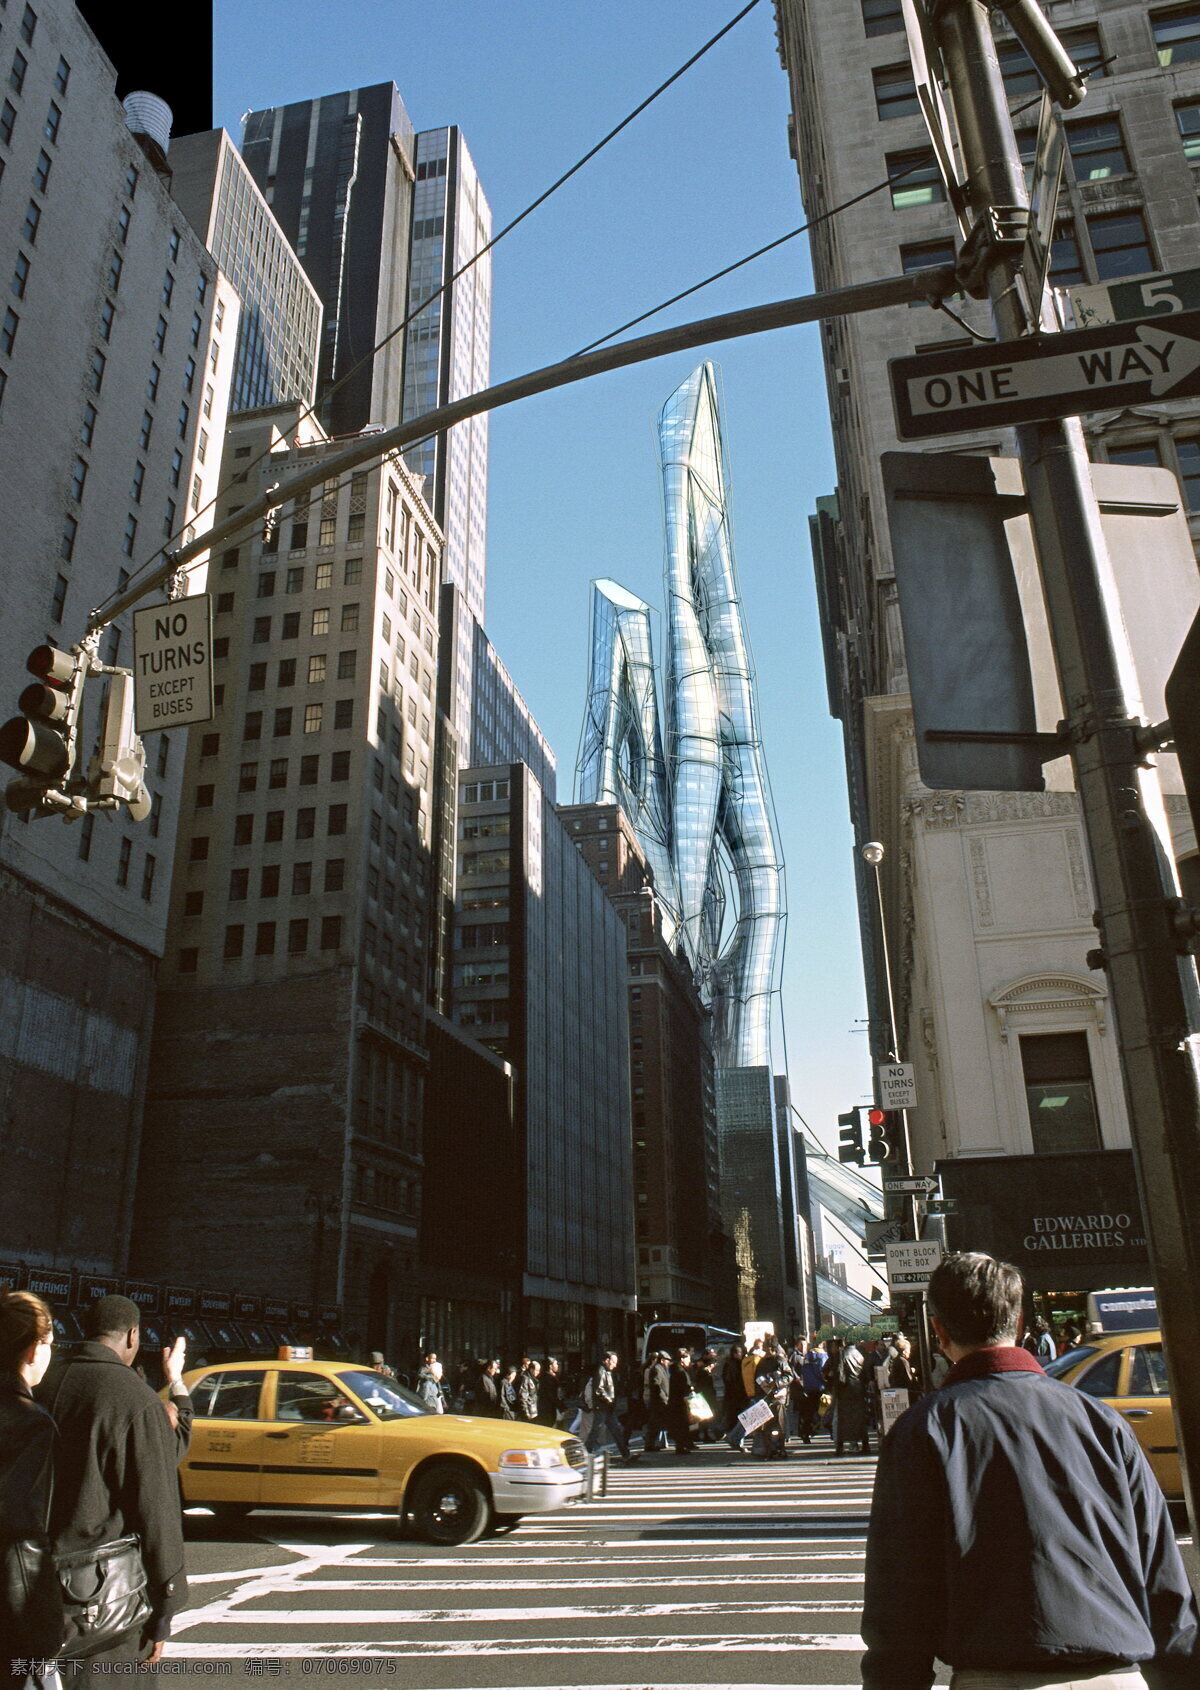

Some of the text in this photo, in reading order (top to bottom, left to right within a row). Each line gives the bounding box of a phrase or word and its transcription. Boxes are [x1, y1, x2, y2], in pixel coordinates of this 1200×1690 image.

[1139, 278, 1184, 313] 5
[923, 340, 1176, 409] ONE WAY
[155, 613, 188, 641] NO
[139, 641, 206, 676] TURNS
[149, 676, 196, 699] EXCEPT
[152, 697, 194, 718] BUSES
[888, 1067, 905, 1077] NO
[881, 1078, 914, 1090] TURNS
[888, 1090, 910, 1098] EXCEPT
[889, 1098, 910, 1106] BUSES
[887, 1180, 932, 1190] ONE WAY
[934, 1201, 942, 1213] 5
[1033, 1213, 1131, 1233] EDWARDO
[1023, 1231, 1147, 1251] GALLERIES LTD
[889, 1247, 937, 1258] DON'T BLOCK
[898, 1257, 930, 1268] THE BOX
[30, 1279, 69, 1295] PERFUMES
[89, 1286, 107, 1298] TOYS
[129, 1291, 154, 1304] CRAFTS
